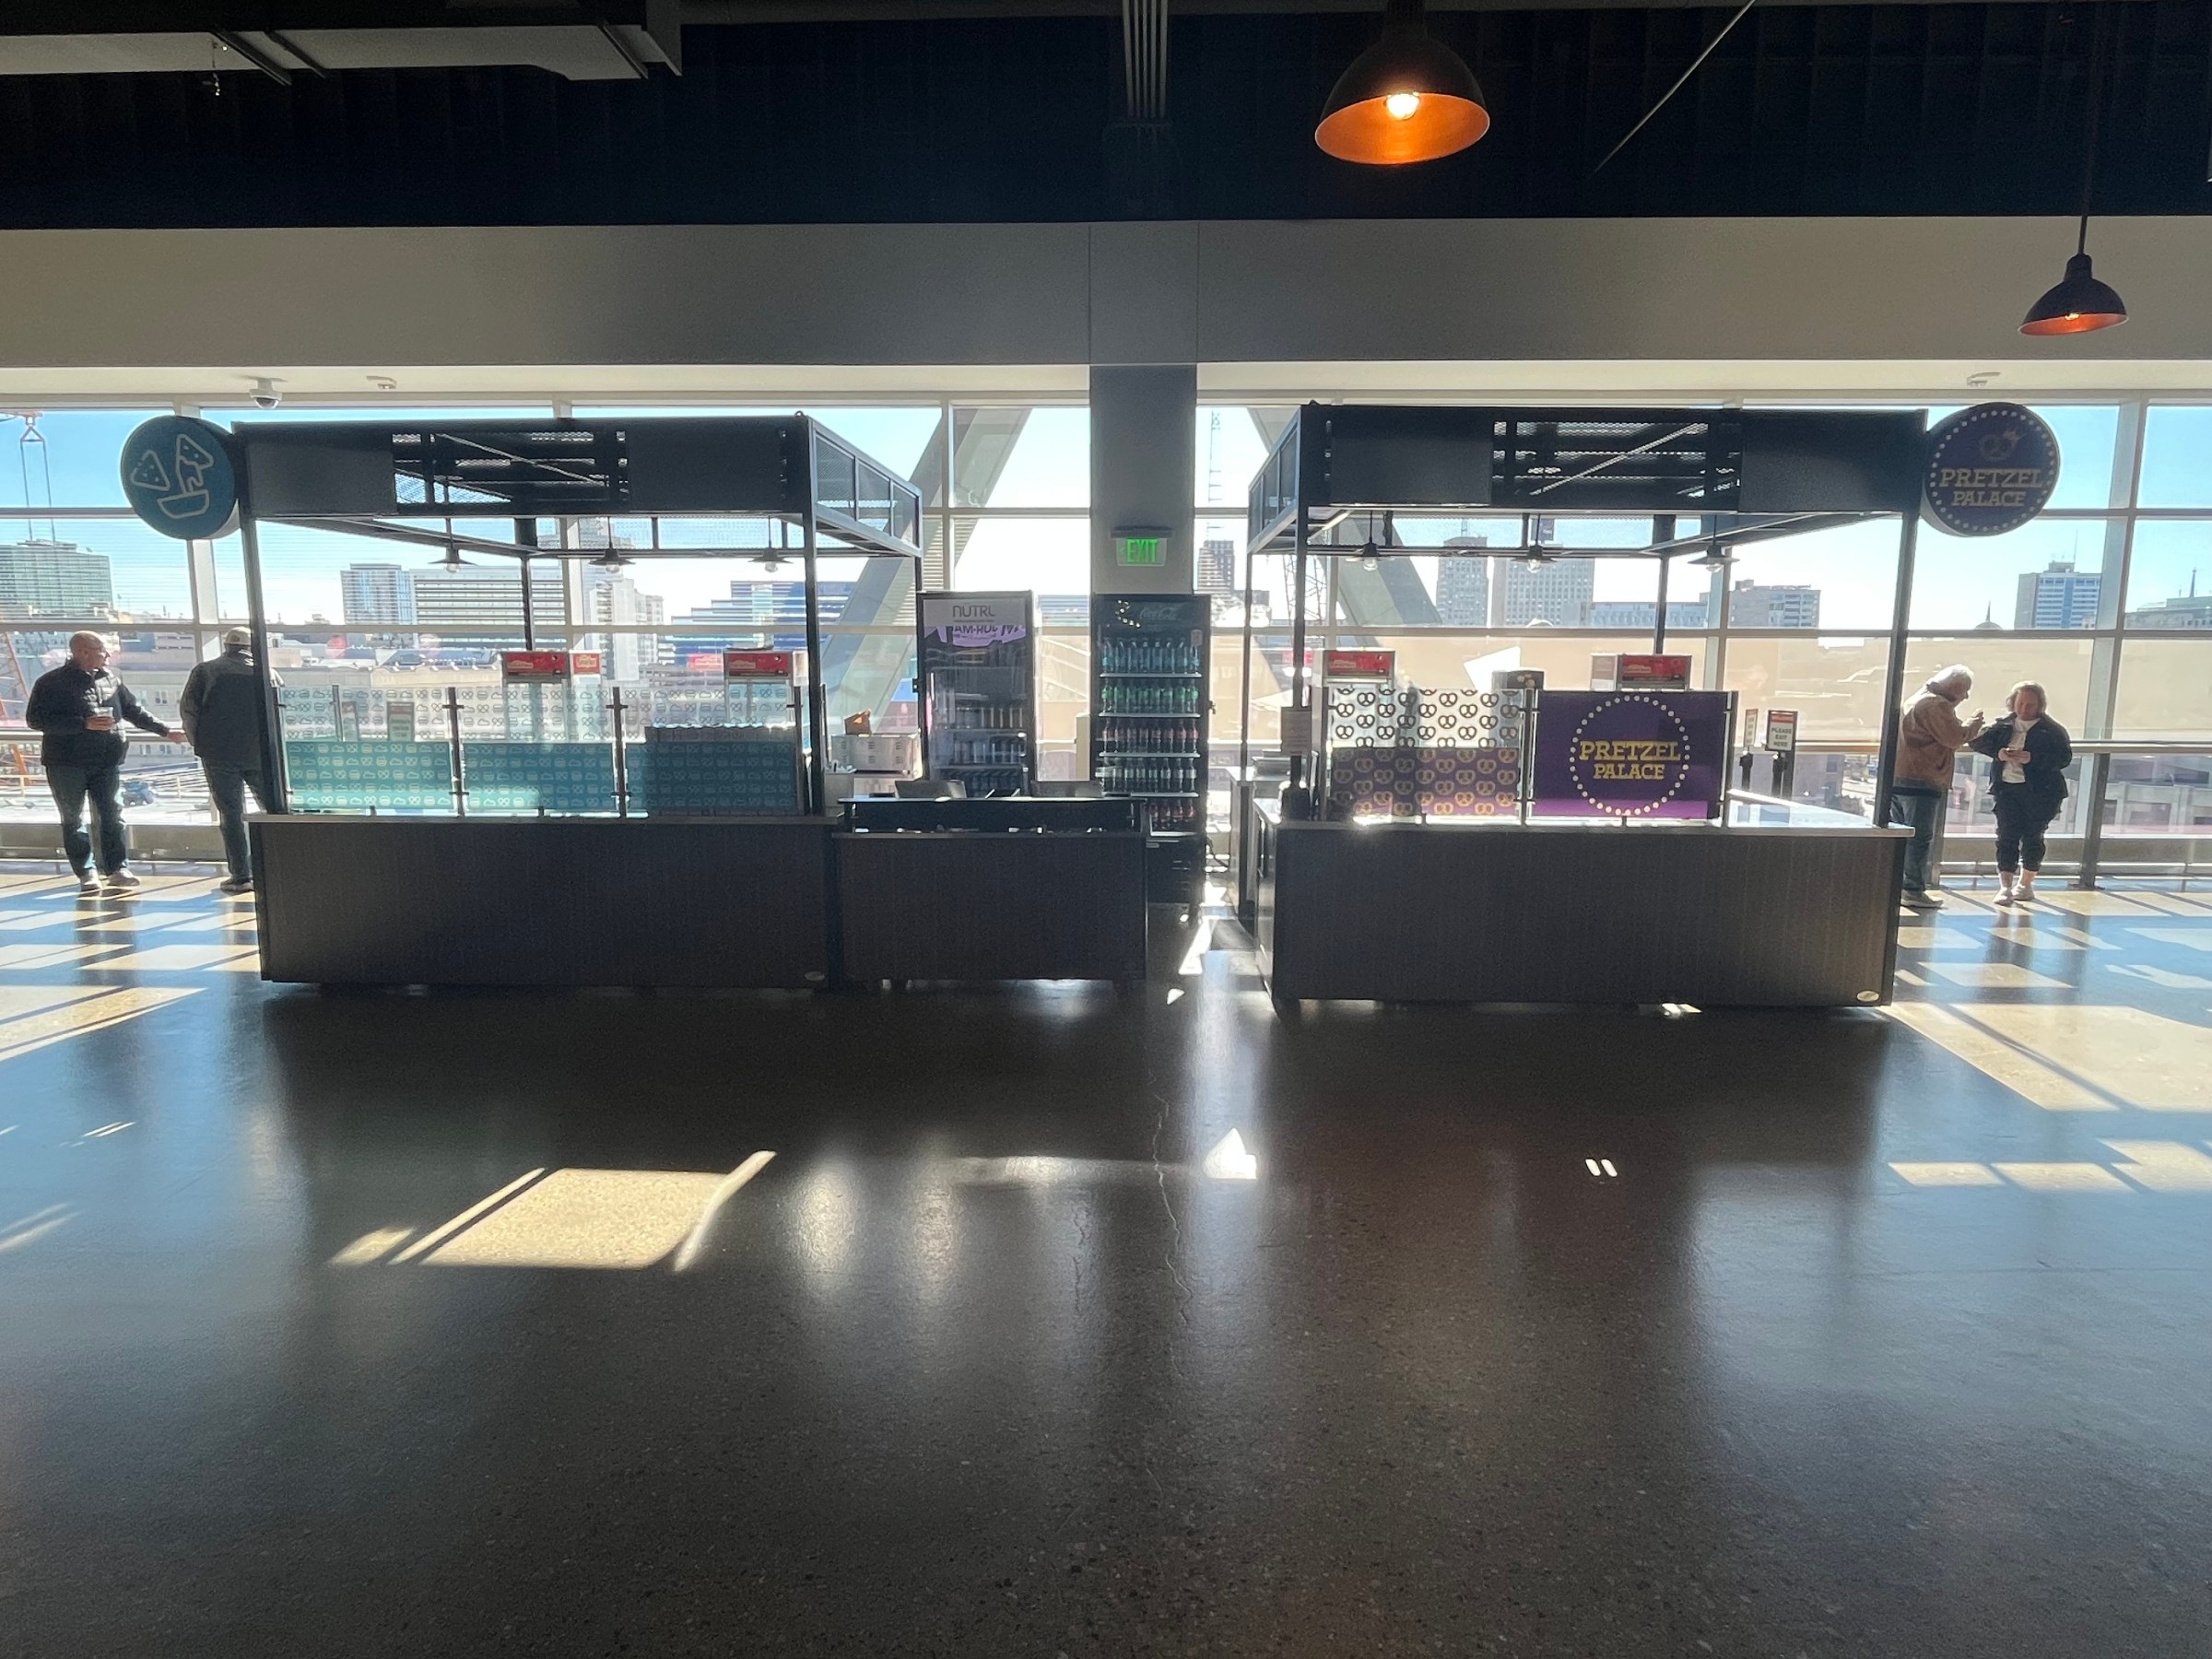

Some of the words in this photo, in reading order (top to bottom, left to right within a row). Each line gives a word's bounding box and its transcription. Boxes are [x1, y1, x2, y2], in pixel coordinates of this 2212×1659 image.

[1939, 468, 2043, 488] PRETZEL
[1951, 490, 2027, 506] PALACE
[1126, 537, 1158, 563] EXIT
[1579, 740, 1681, 761] PRETZEL
[1593, 763, 1665, 779] PALACE
